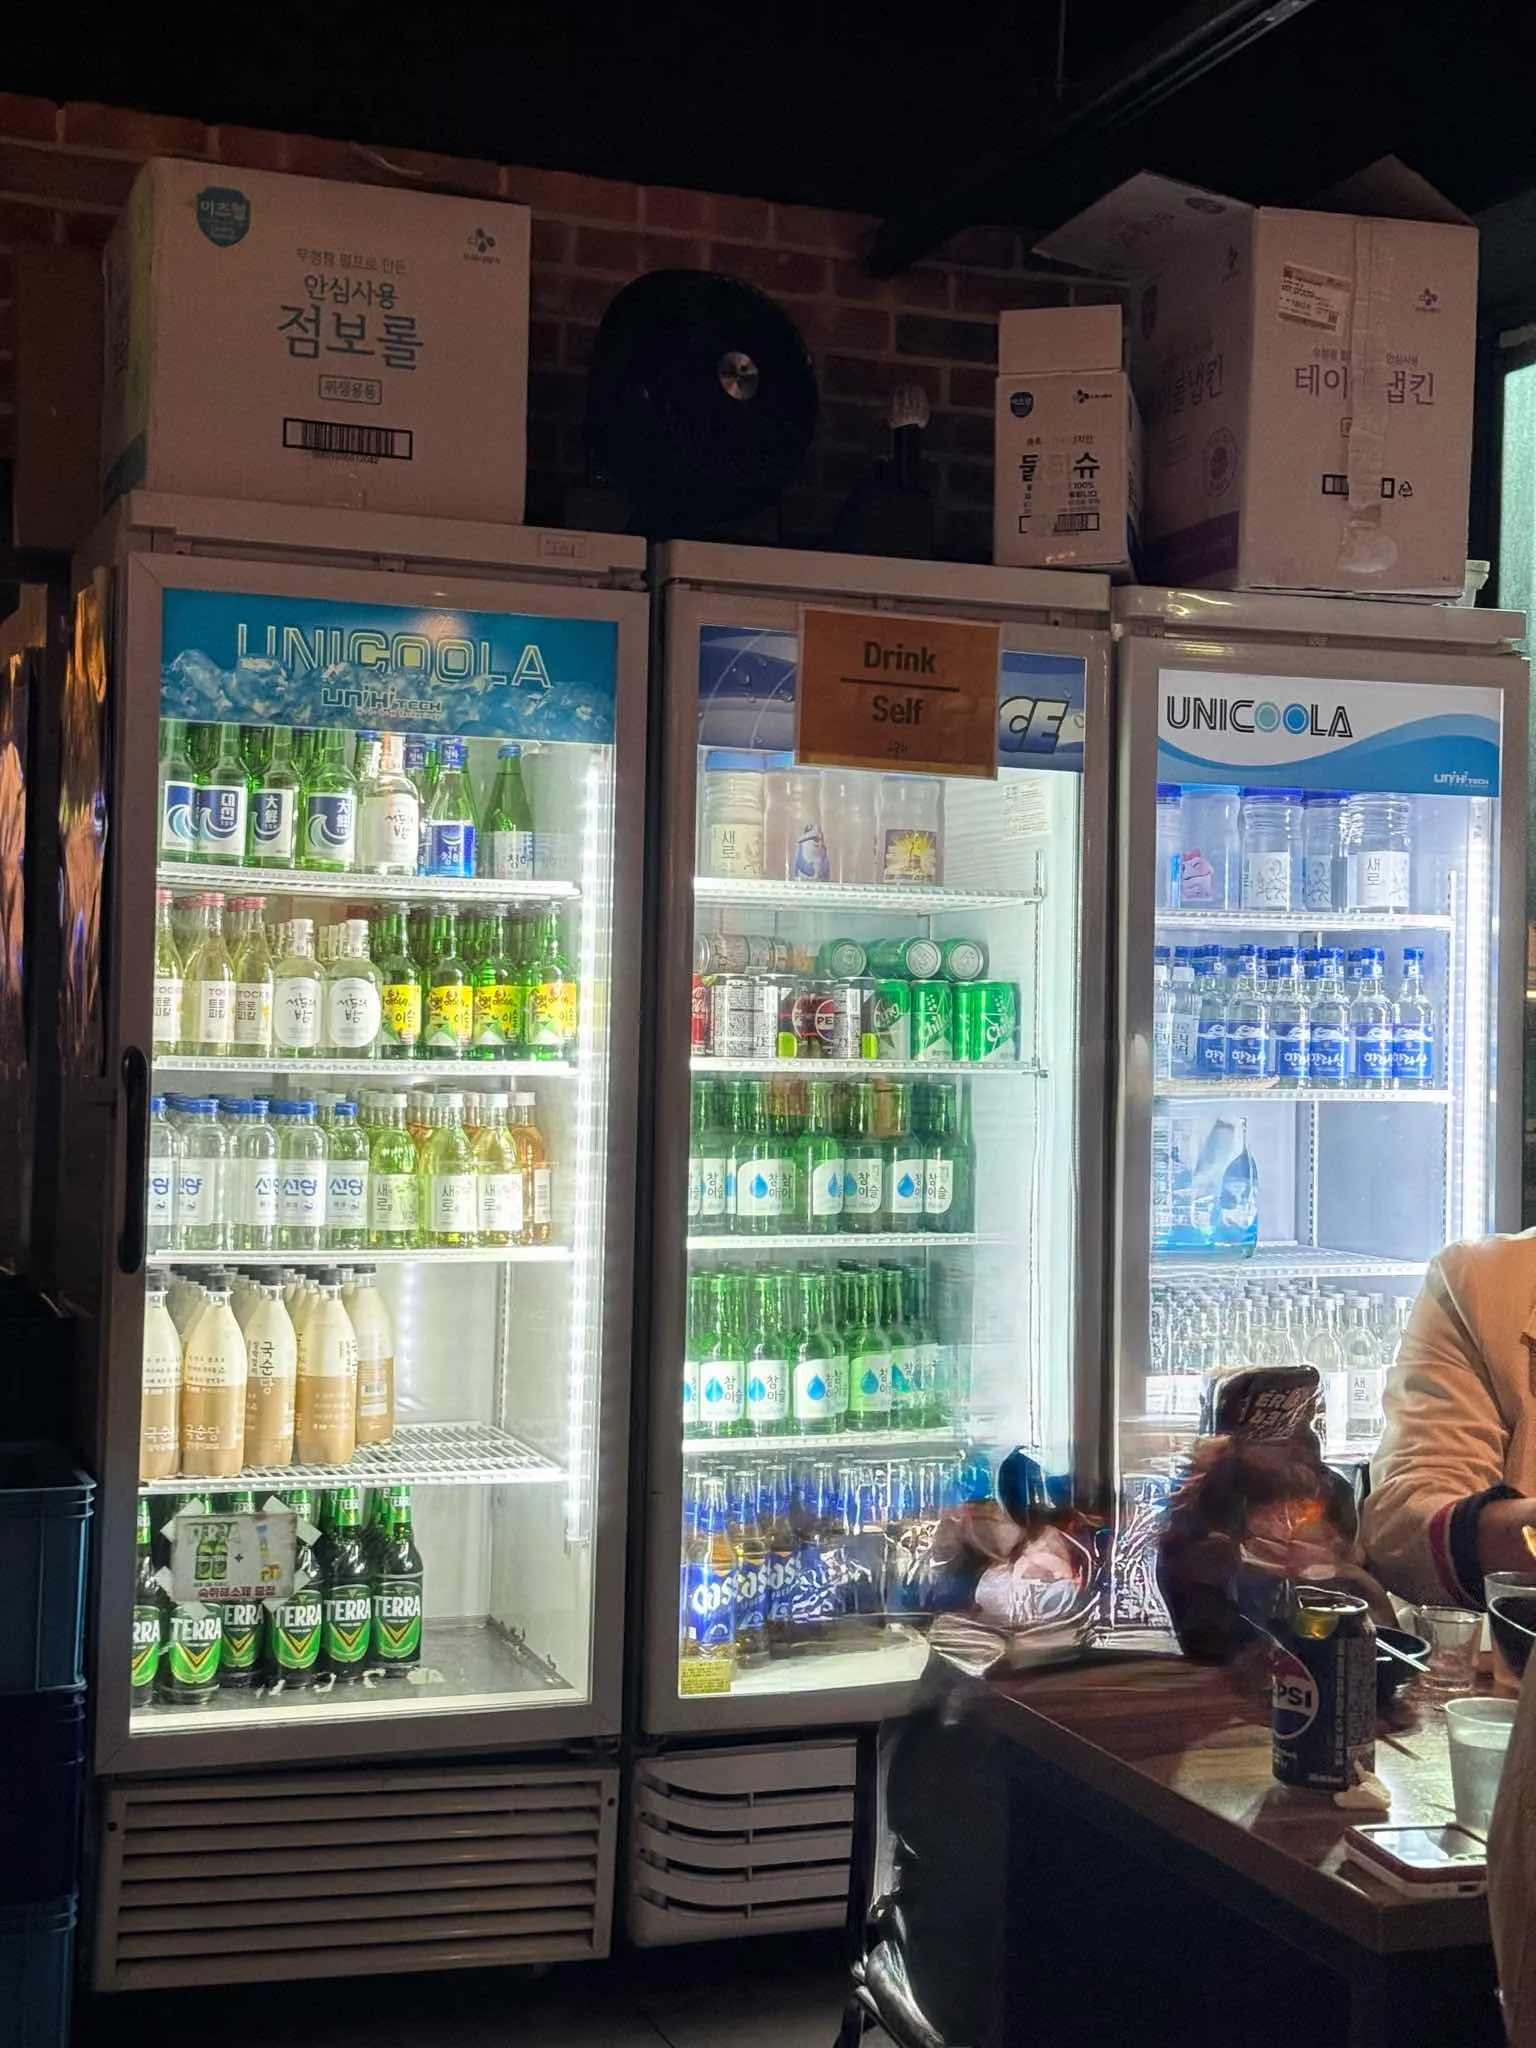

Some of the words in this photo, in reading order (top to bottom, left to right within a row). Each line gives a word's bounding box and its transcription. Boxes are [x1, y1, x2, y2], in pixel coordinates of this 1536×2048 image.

[304, 273, 400, 310] 안심사용
[278, 302, 425, 371] 점보롤
[237, 622, 555, 690] UNICOOLA
[863, 640, 938, 674] Drink
[872, 696, 924, 726] Self
[1166, 695, 1354, 738] UNICOOLA
[260, 1341, 276, 1395] 국순당
[184, 1424, 220, 1441] 국순당
[224, 1603, 265, 1626] ERRA
[275, 1603, 322, 1628] TERRA
[325, 1597, 372, 1621] TERRA
[373, 1595, 421, 1617] TERRA
[132, 1619, 161, 1643] RRA
[170, 1617, 222, 1641] TERRA
